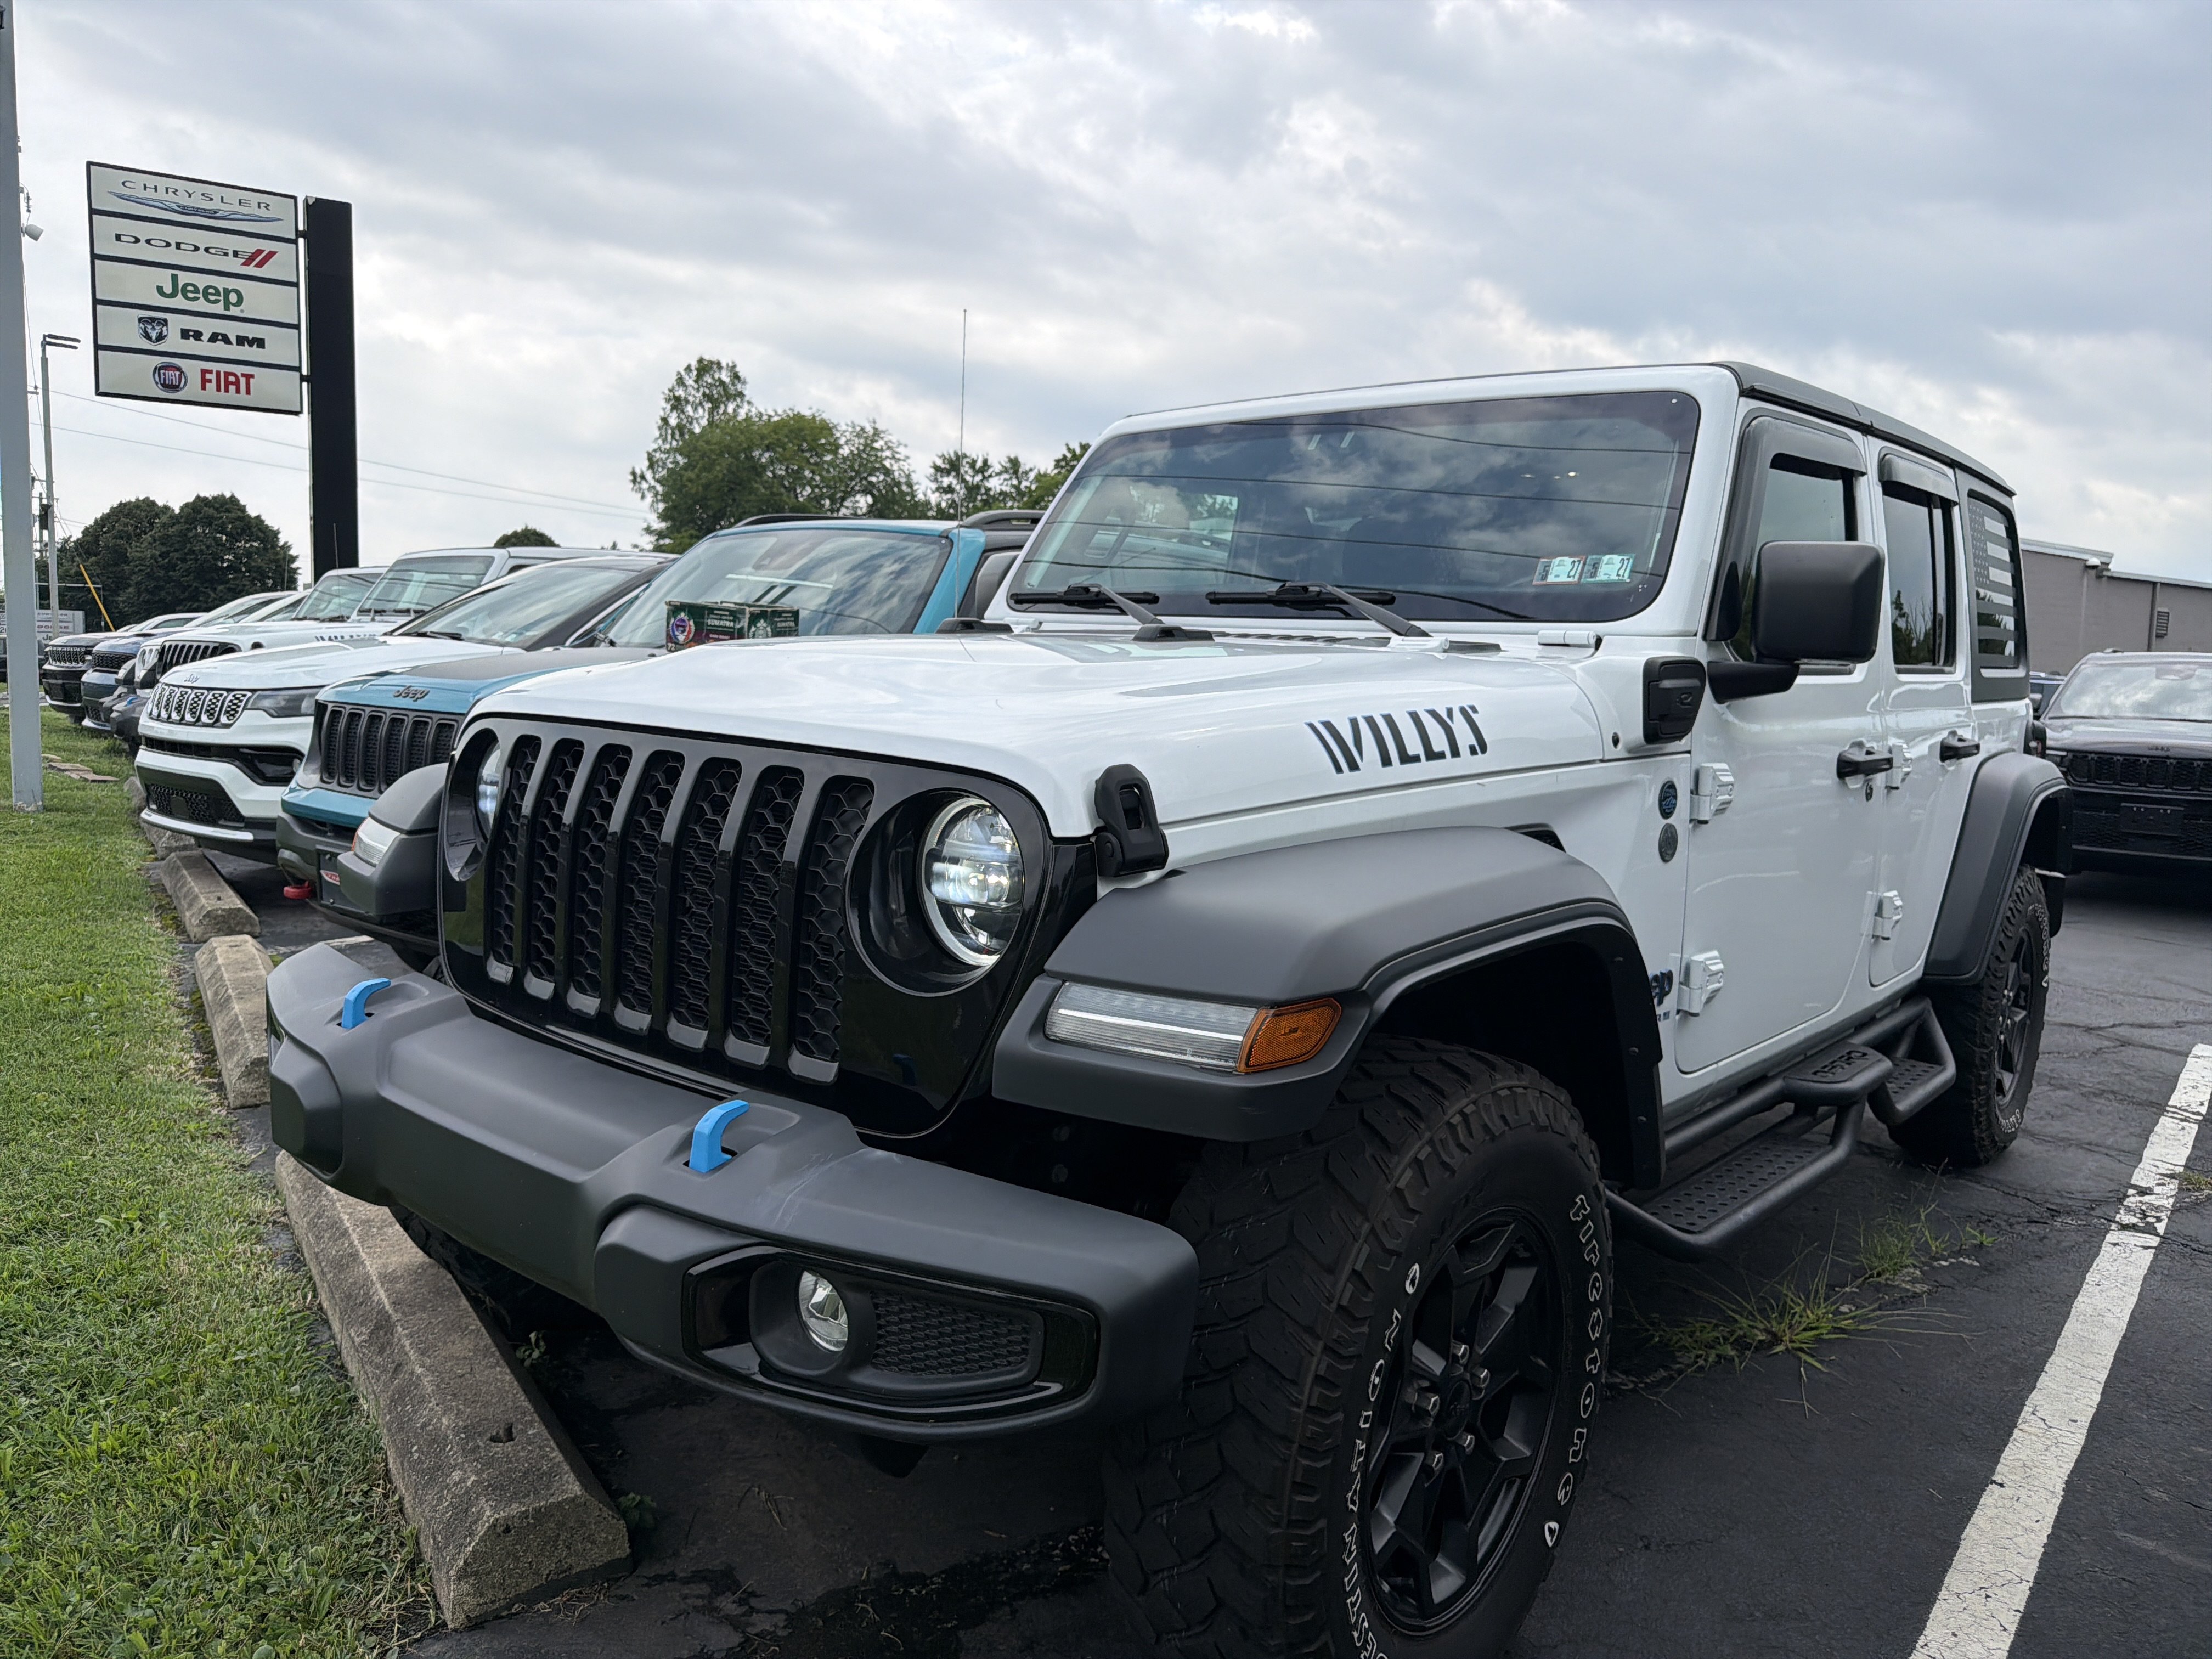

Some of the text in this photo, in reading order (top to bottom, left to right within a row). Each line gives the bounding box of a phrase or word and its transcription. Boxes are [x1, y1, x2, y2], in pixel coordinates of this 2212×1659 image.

[121, 180, 271, 211] CHRYSLER
[115, 233, 256, 259] DODGE
[156, 273, 244, 311] Jeep
[180, 328, 266, 349] RAM
[160, 369, 180, 387] FIAT
[200, 368, 255, 396] FIAT
[707, 619, 734, 627] SUMATRA
[393, 685, 430, 702] Jeep
[1305, 704, 1487, 774] WILLYS
